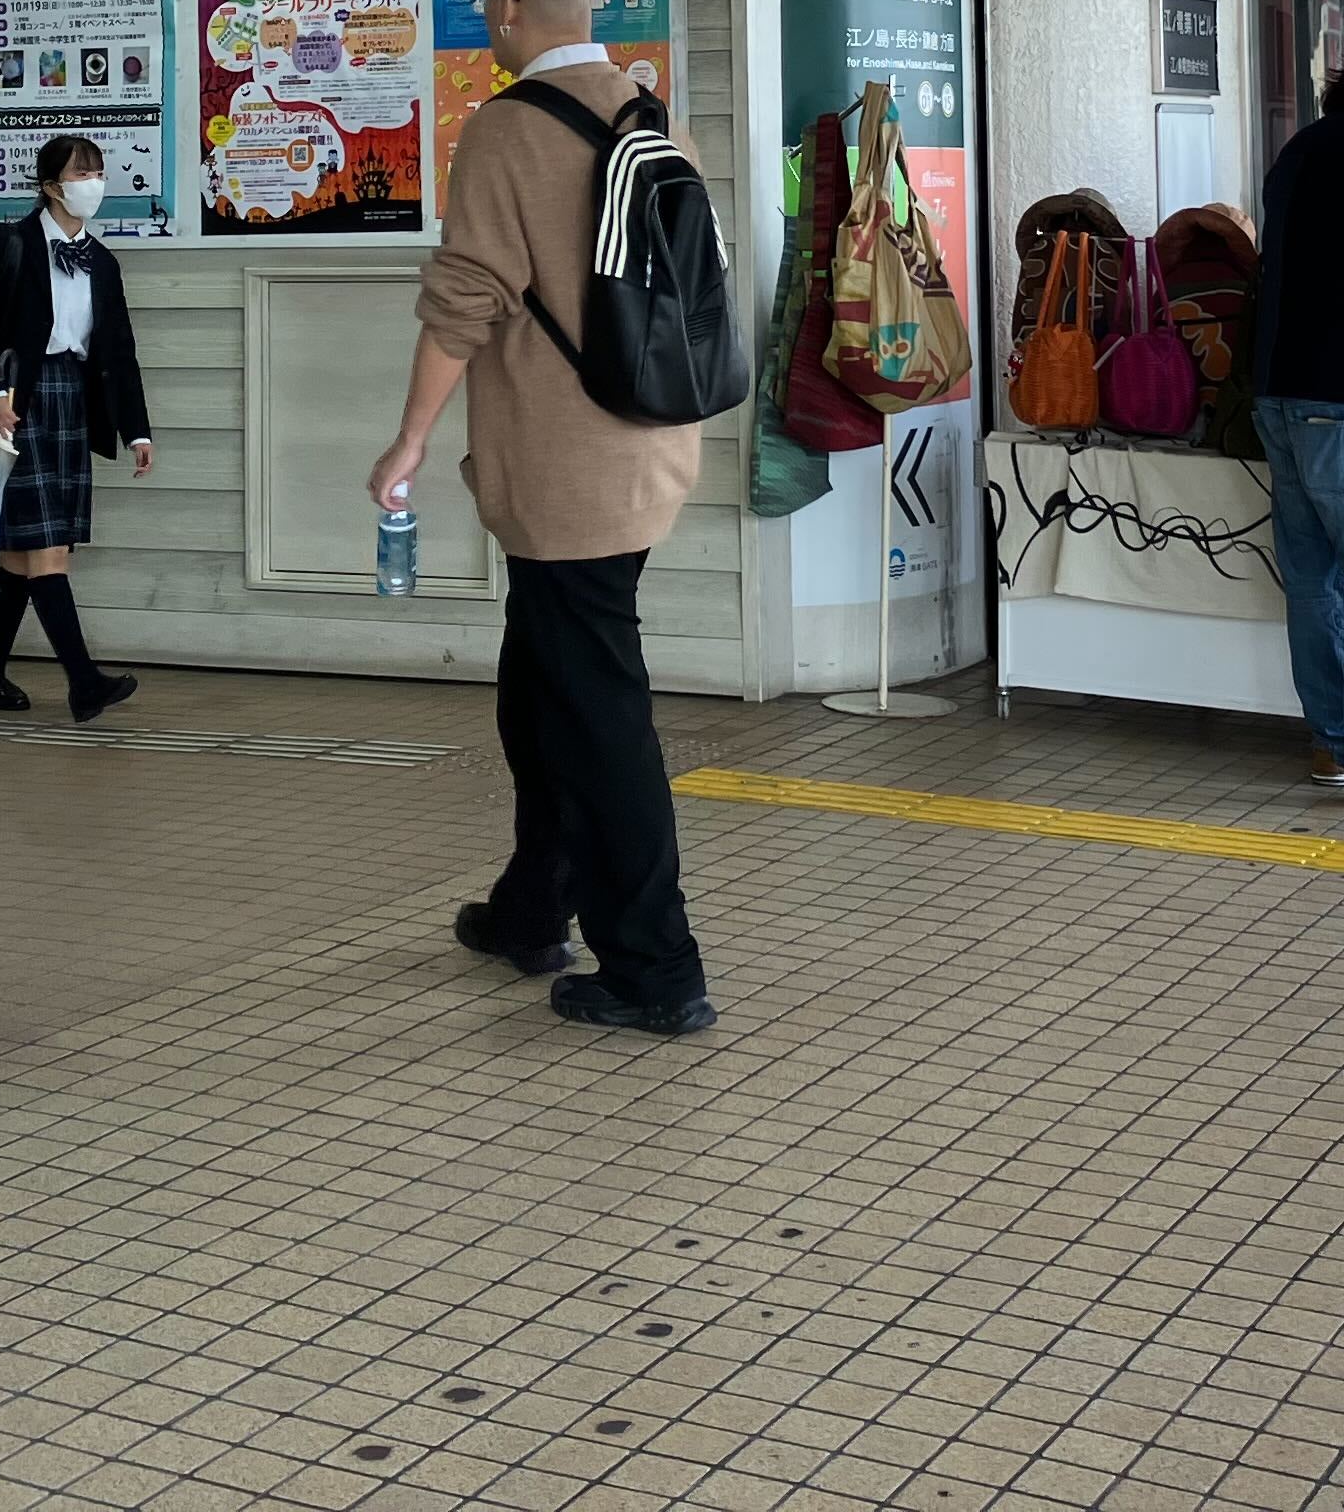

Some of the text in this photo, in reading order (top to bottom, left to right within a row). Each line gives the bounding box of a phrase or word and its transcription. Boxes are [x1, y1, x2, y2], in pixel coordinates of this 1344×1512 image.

[846, 56, 861, 68] for
[232, 110, 327, 127] 仮装フォトコンテスト
